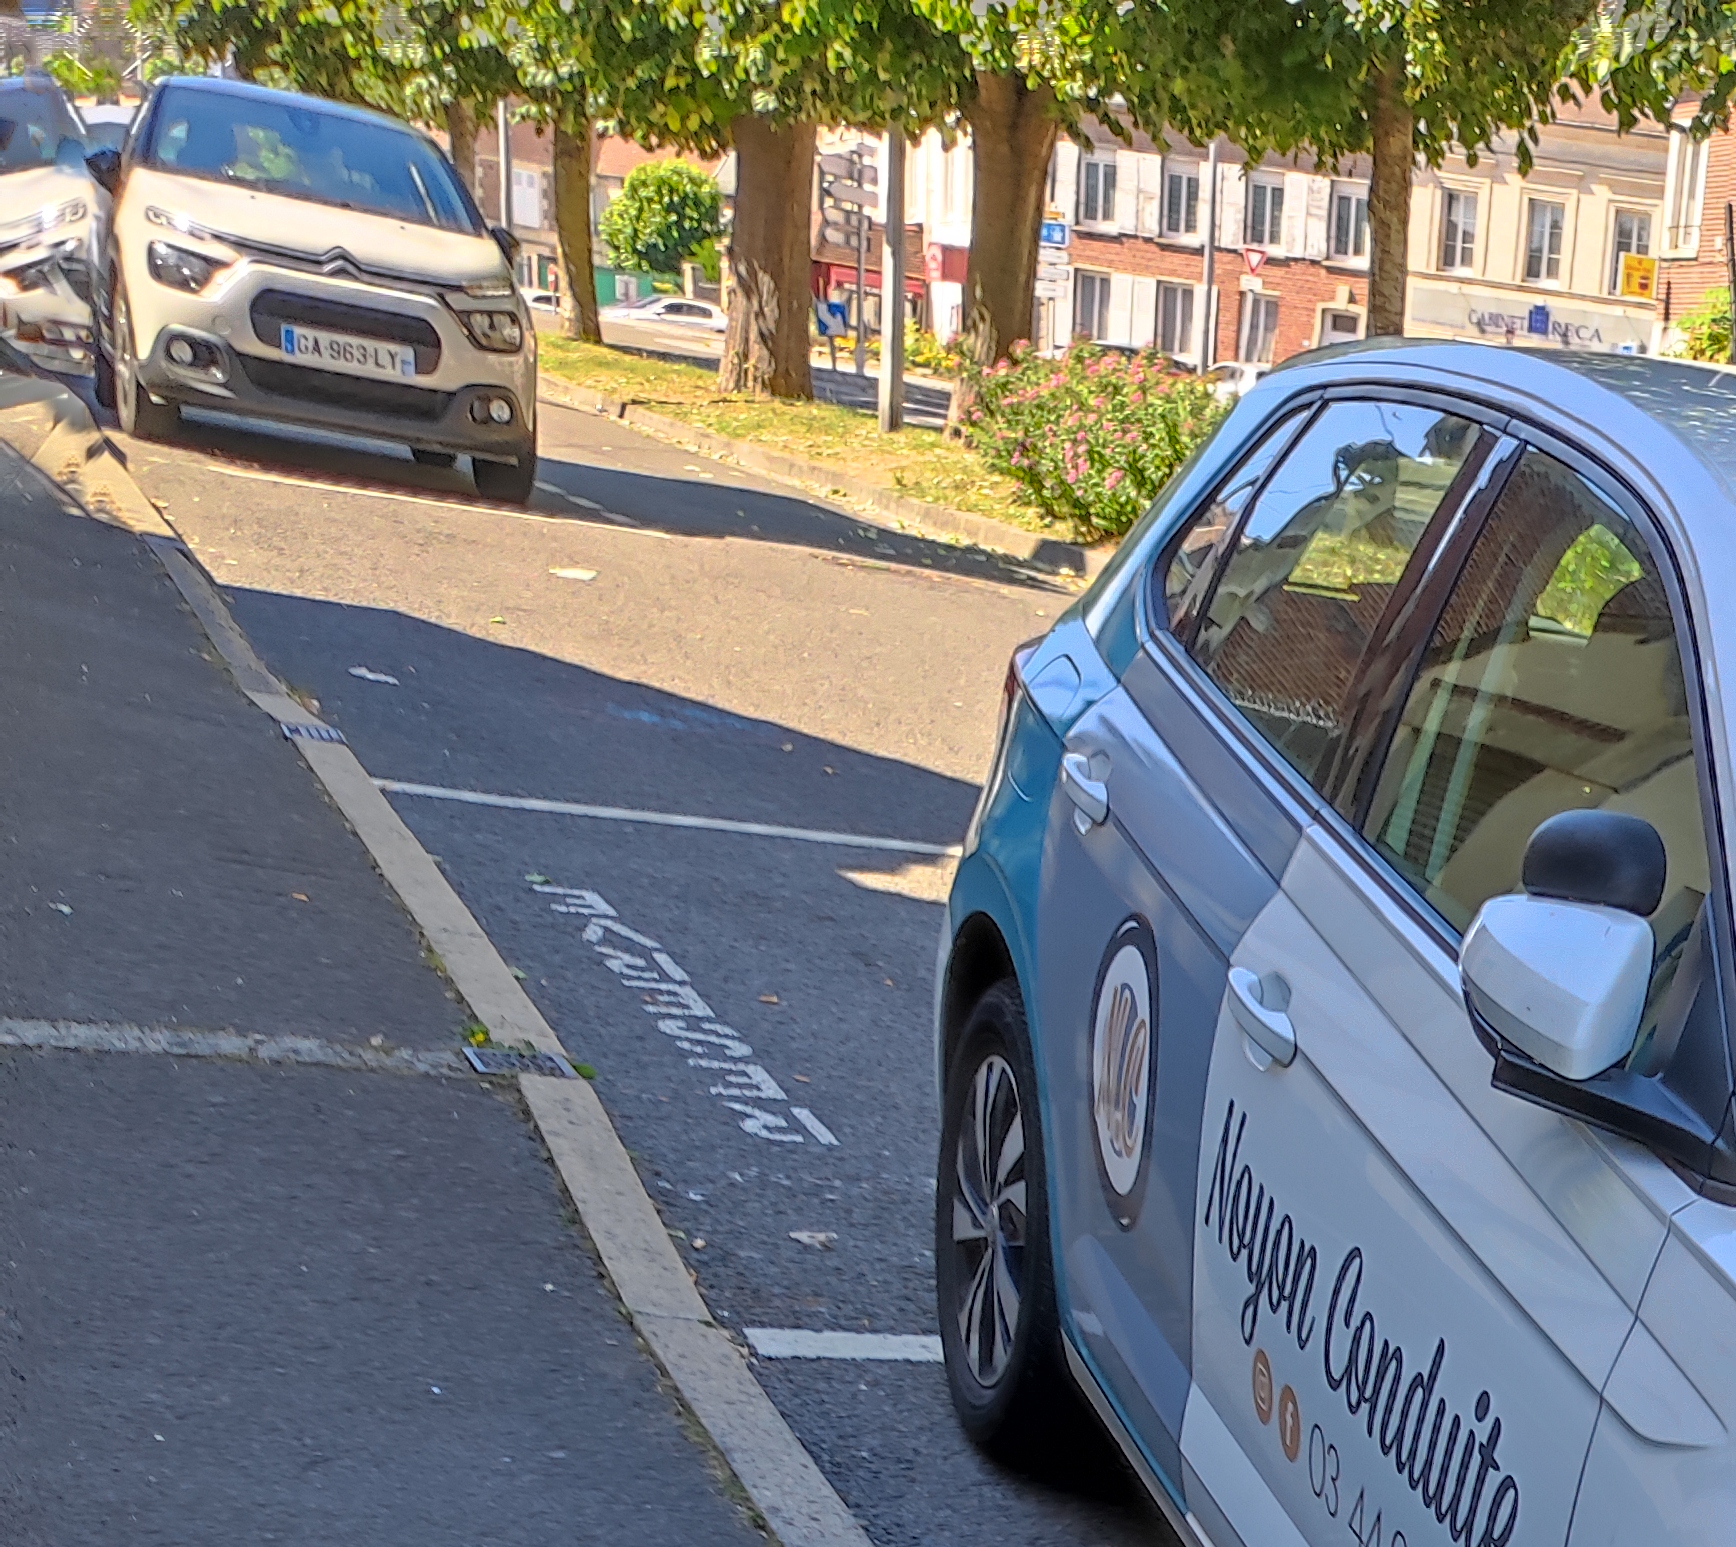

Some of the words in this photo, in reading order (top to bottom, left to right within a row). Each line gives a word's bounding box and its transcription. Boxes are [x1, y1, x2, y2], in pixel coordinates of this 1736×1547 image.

[532, 883, 841, 1146] RESERVE
[1204, 1098, 1317, 1351] Noyon
[1308, 1423, 1340, 1518] 03
